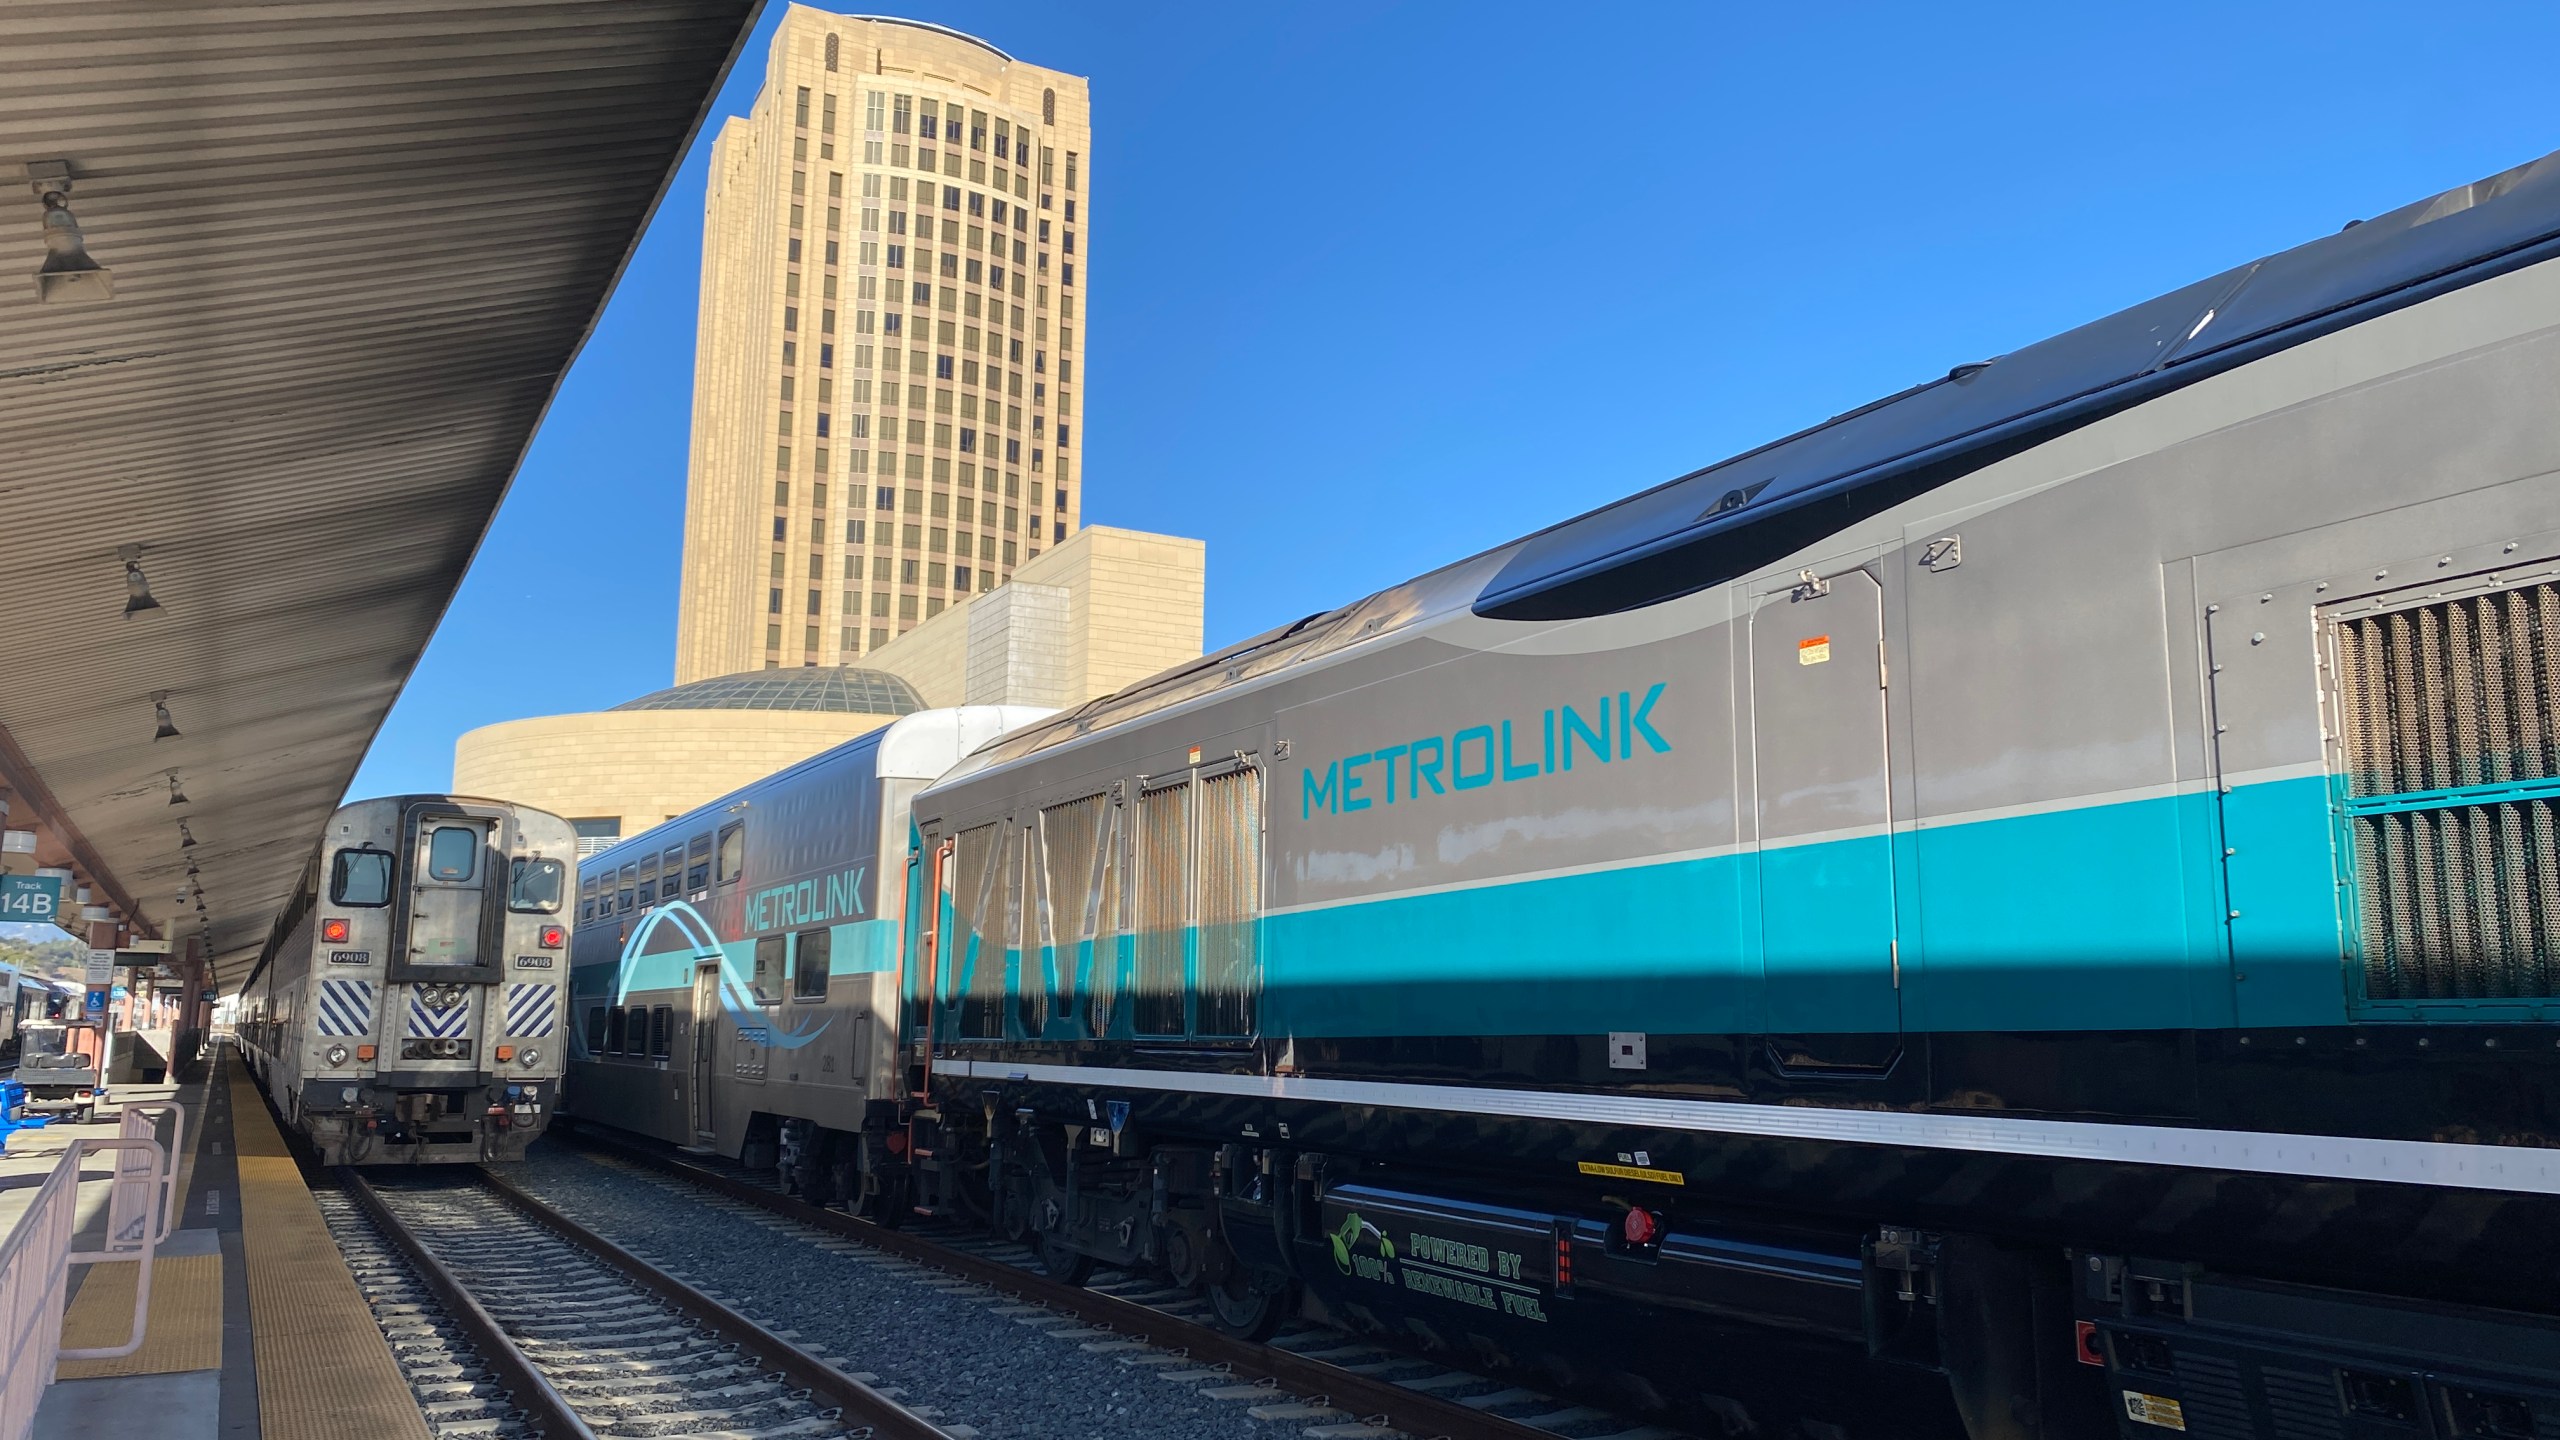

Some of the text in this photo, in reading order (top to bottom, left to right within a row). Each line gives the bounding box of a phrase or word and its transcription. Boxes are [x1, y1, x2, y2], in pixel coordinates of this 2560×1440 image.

[1303, 682, 1672, 820] METROLINK
[16, 881, 42, 890] Track
[744, 866, 866, 933] METROLINK
[1, 892, 52, 914] 14B
[333, 952, 367, 963] 6908
[520, 957, 551, 967] 6908
[1352, 1254, 1395, 1284] 100%
[1410, 1233, 1522, 1280] POWERED BY
[1401, 1268, 1548, 1322] RENEWABLE FUEL
